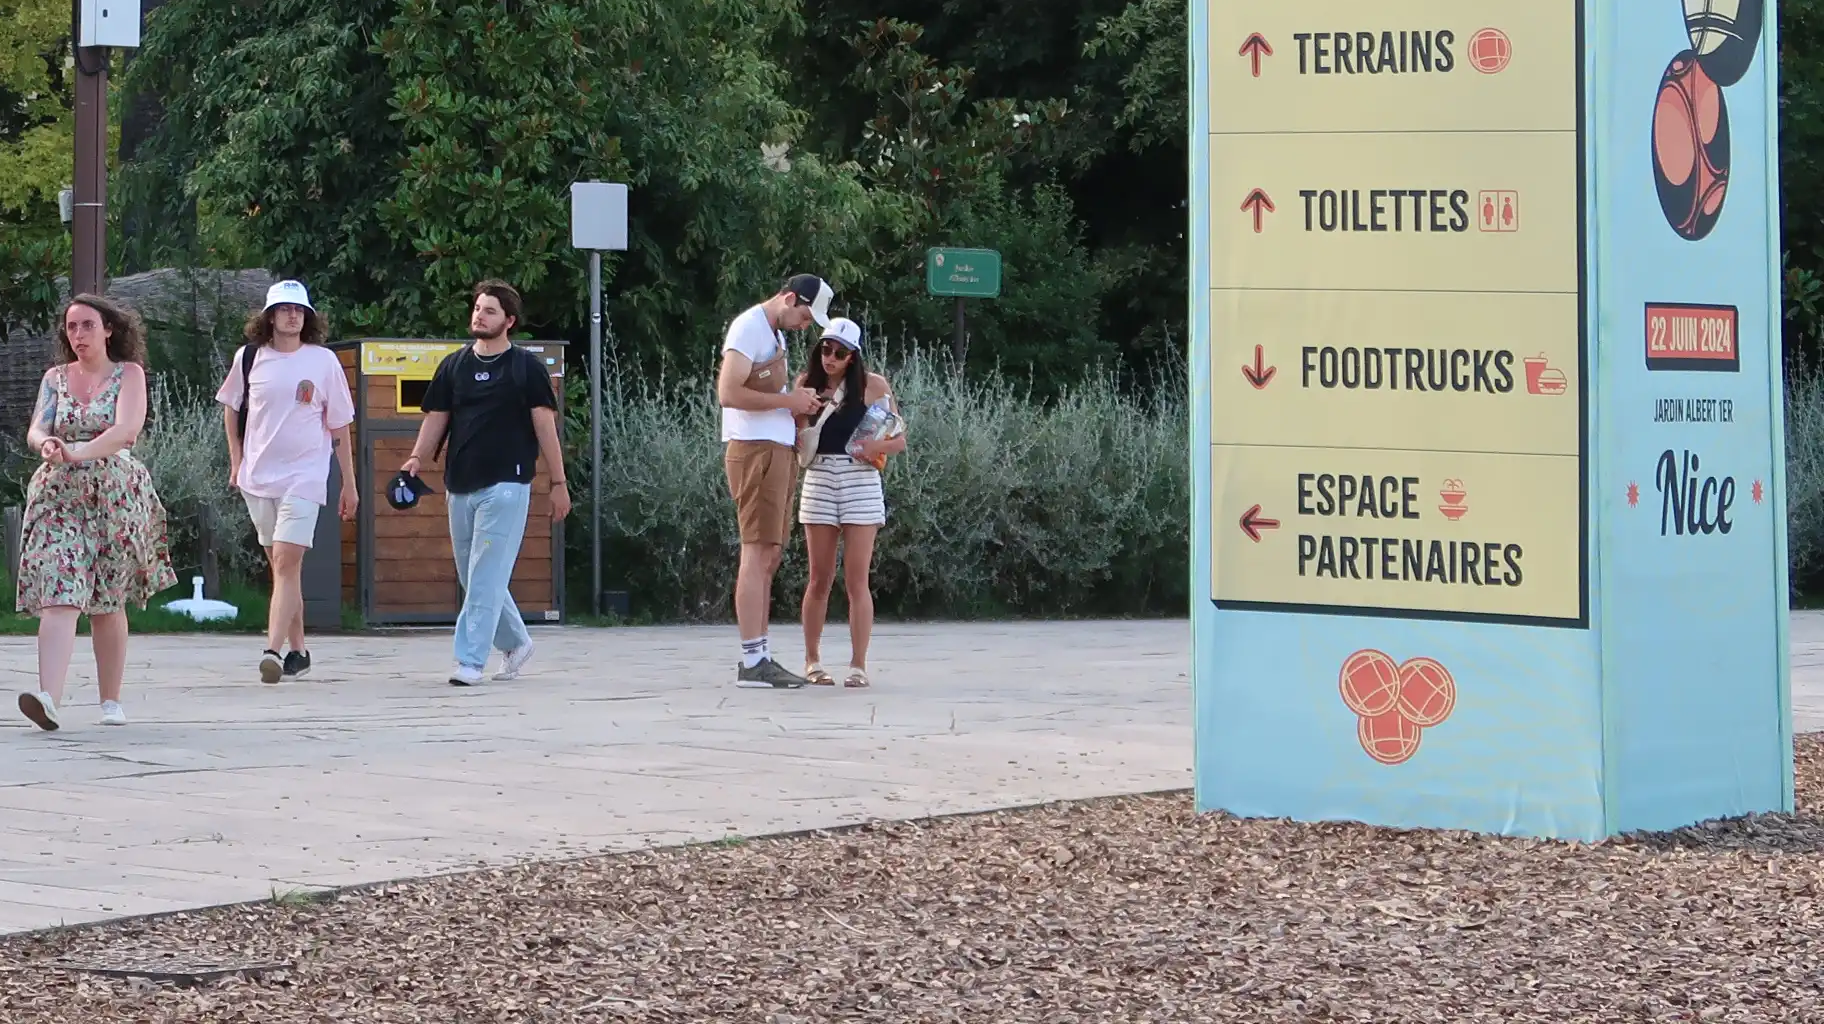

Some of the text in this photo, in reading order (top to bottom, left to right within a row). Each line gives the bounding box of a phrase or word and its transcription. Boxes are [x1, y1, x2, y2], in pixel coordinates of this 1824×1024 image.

[1293, 30, 1455, 74] TERRAINS
[1299, 189, 1469, 232] TOILETTES
[1651, 316, 1732, 352] 22 JUIN 2024
[1302, 346, 1514, 394] FOODTRUCKS
[1654, 398, 1733, 423] JARDIN ALBERT 1ER
[1298, 473, 1420, 519] ESPACE
[1656, 449, 1735, 536] Nice
[1298, 534, 1523, 587] PARTENAIRES
